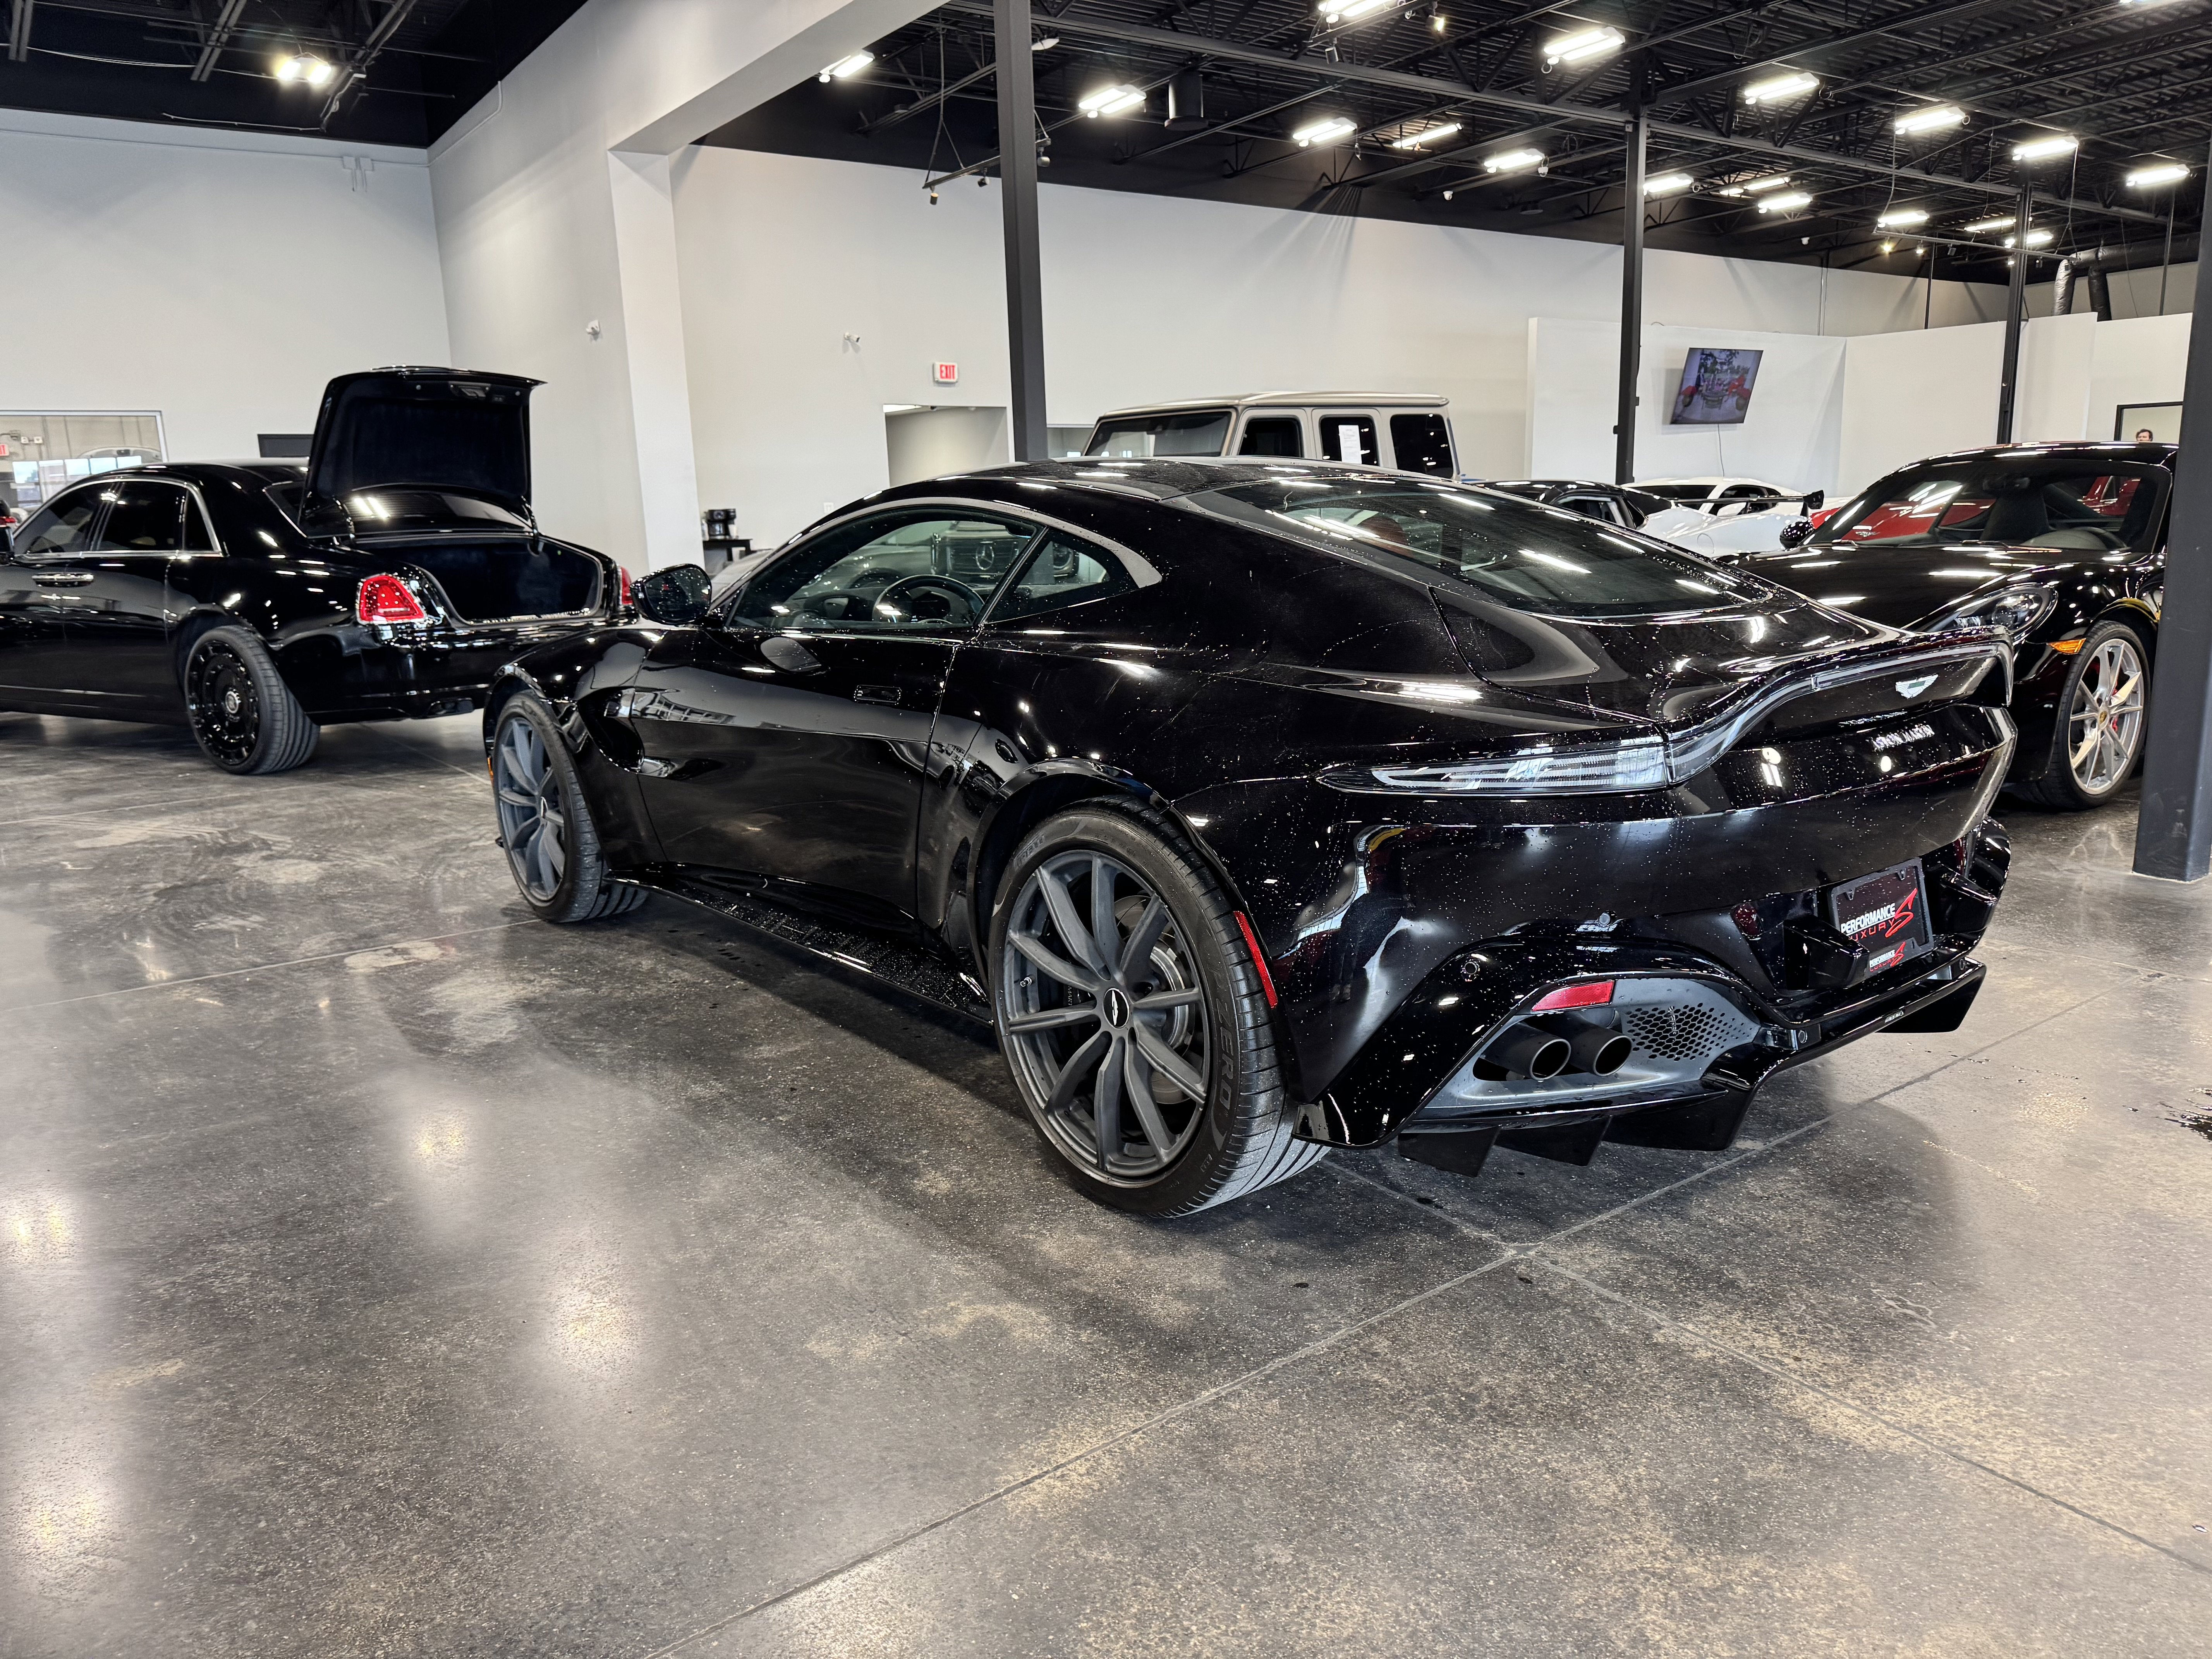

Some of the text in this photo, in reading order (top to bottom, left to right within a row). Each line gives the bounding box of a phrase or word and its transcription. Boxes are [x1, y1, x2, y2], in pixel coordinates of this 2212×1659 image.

[939, 364, 955, 380] EXIT
[1841, 903, 1896, 934] PERFORMANCE
[1849, 918, 1895, 941] UXURY
[1216, 998, 1234, 1110] ZERO
